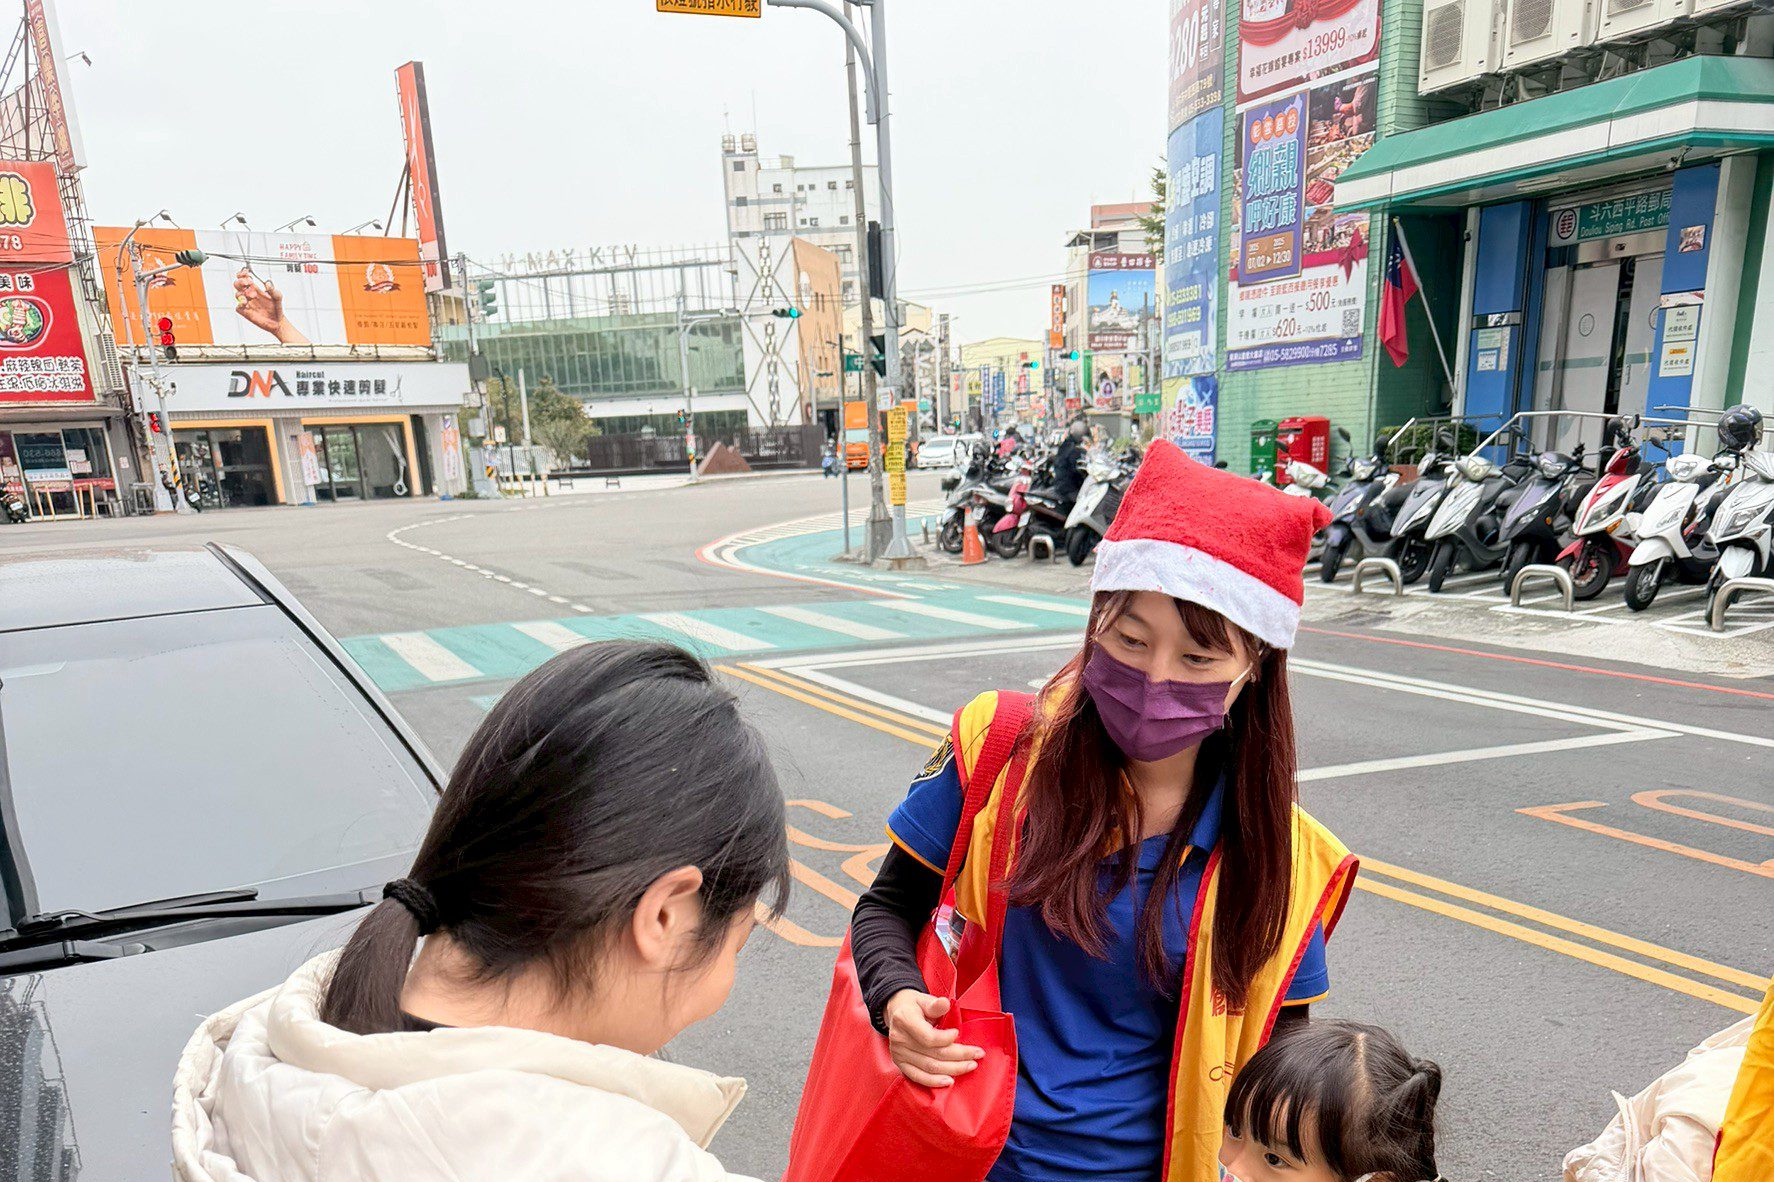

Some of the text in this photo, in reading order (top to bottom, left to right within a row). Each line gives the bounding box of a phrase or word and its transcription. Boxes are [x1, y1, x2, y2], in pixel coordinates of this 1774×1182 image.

[1302, 26, 1346, 60] $13999
[1246, 139, 1299, 199] 鄉親
[1245, 192, 1298, 233] 呷好康
[1589, 190, 1672, 221] 斗六西平路郵局
[1581, 226, 1602, 237] Douliou
[1605, 221, 1624, 234] Siping
[1626, 218, 1637, 229] Rd.
[1640, 216, 1654, 227] Post
[589, 243, 637, 267] KTV
[303, 263, 319, 274] 100
[0, 275, 33, 291] 美味
[227, 370, 293, 398] DNA
[296, 370, 325, 379] Haircut
[296, 378, 387, 396] 專業快速剪髮
